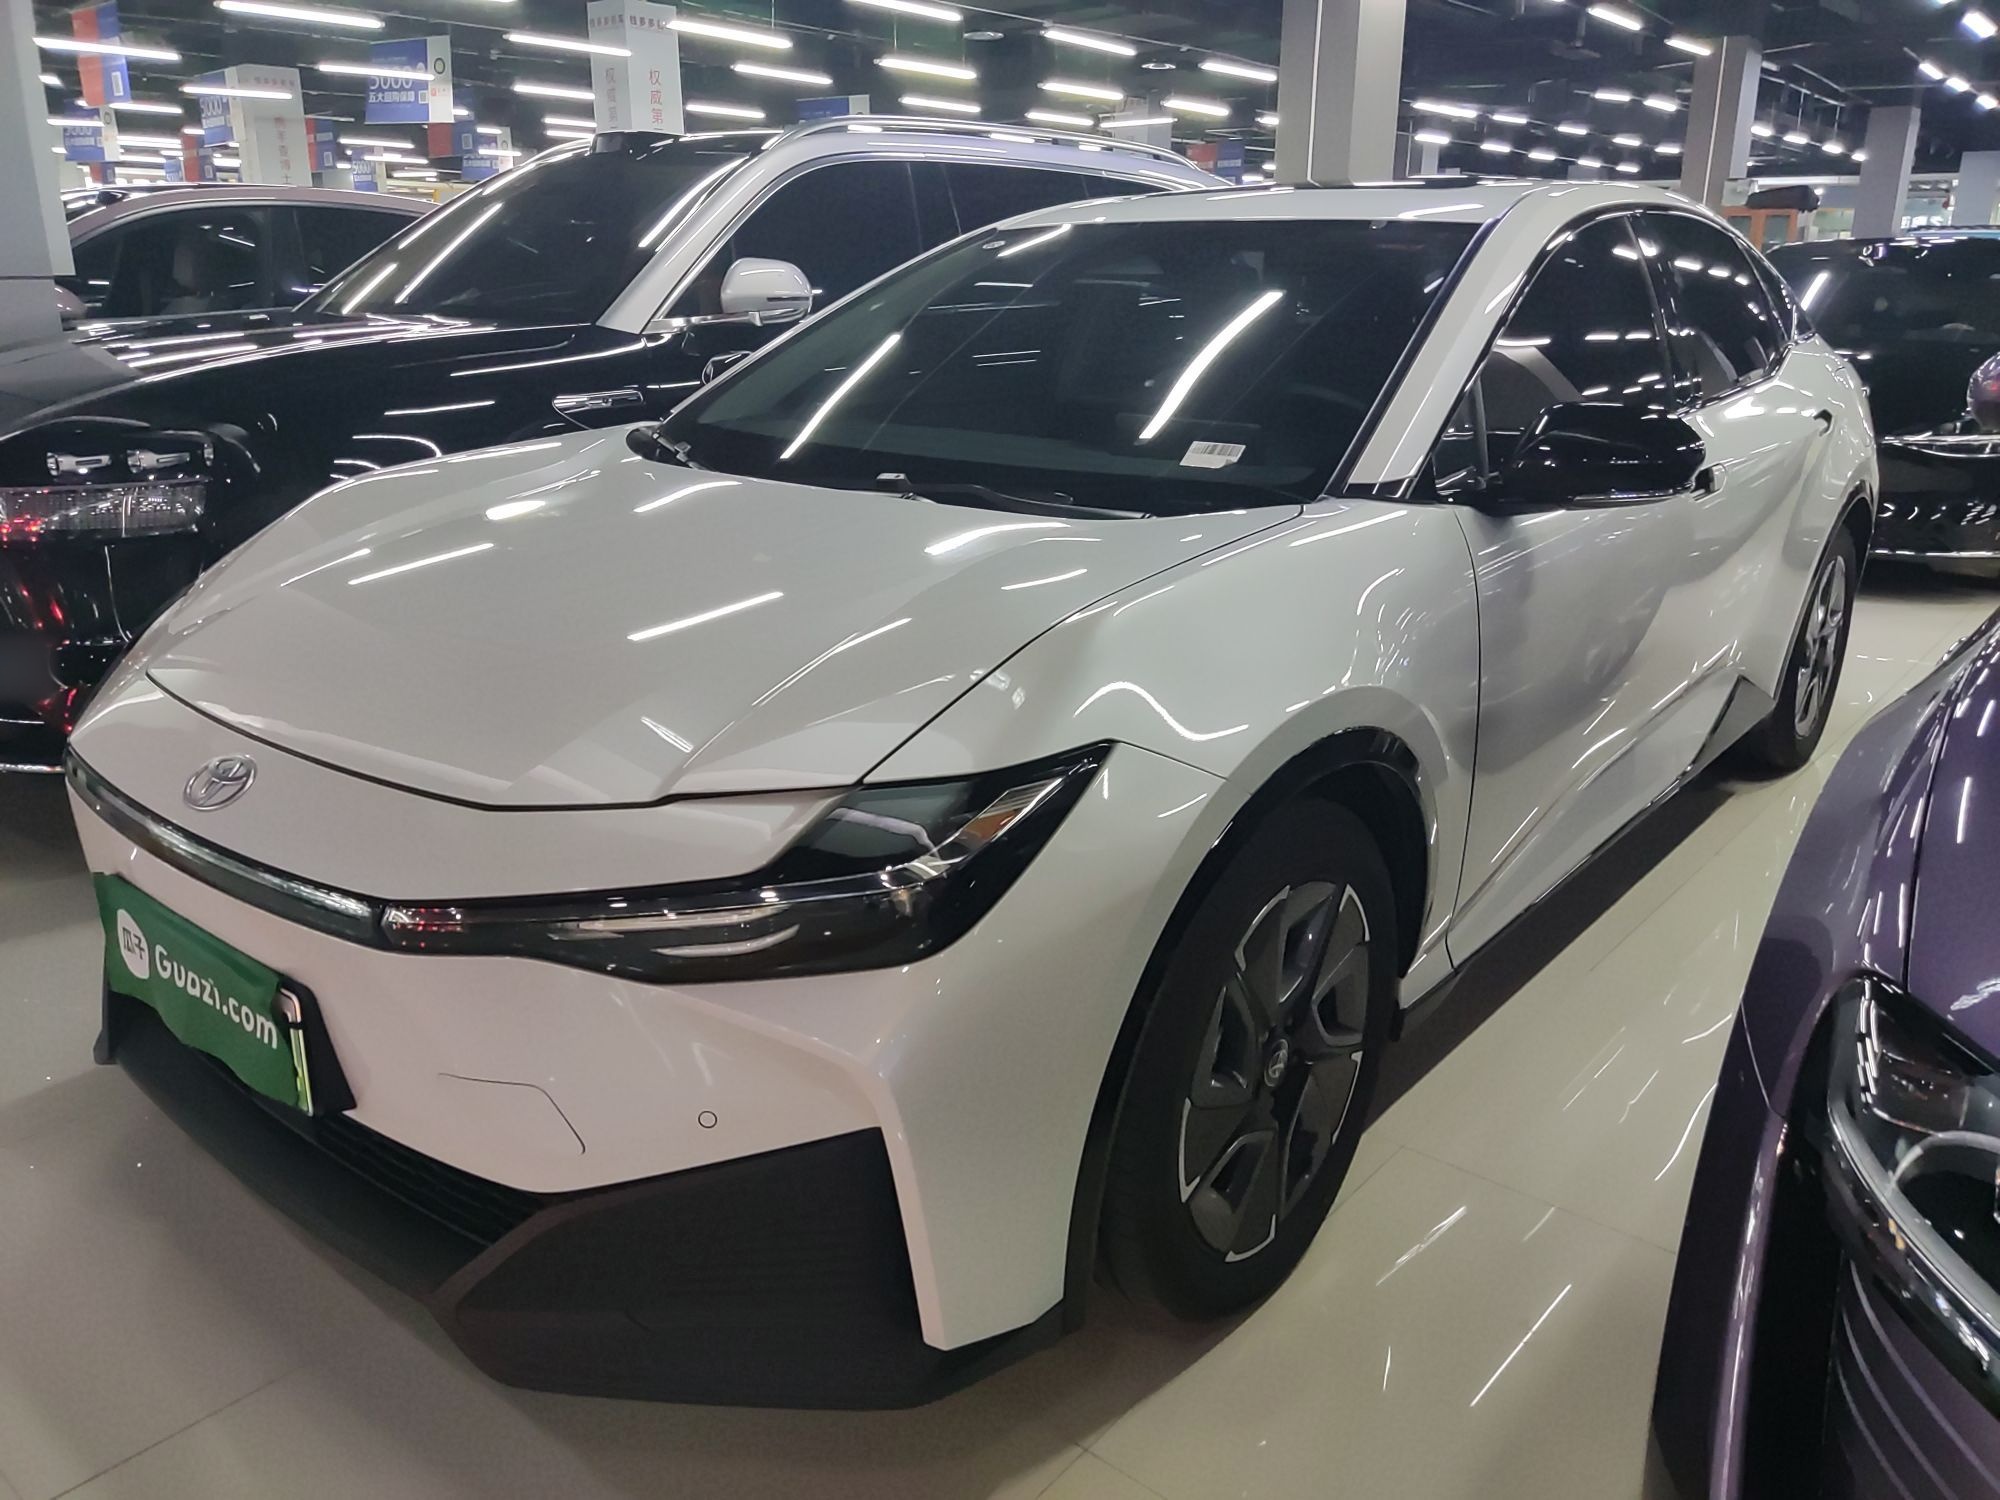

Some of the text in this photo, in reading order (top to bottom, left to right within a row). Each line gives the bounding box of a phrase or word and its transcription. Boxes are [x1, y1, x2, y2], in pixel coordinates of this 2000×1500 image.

[649, 70, 664, 130] 权威第
[122, 927, 145, 960] 瓜子
[154, 943, 278, 1049] Guazi.com
